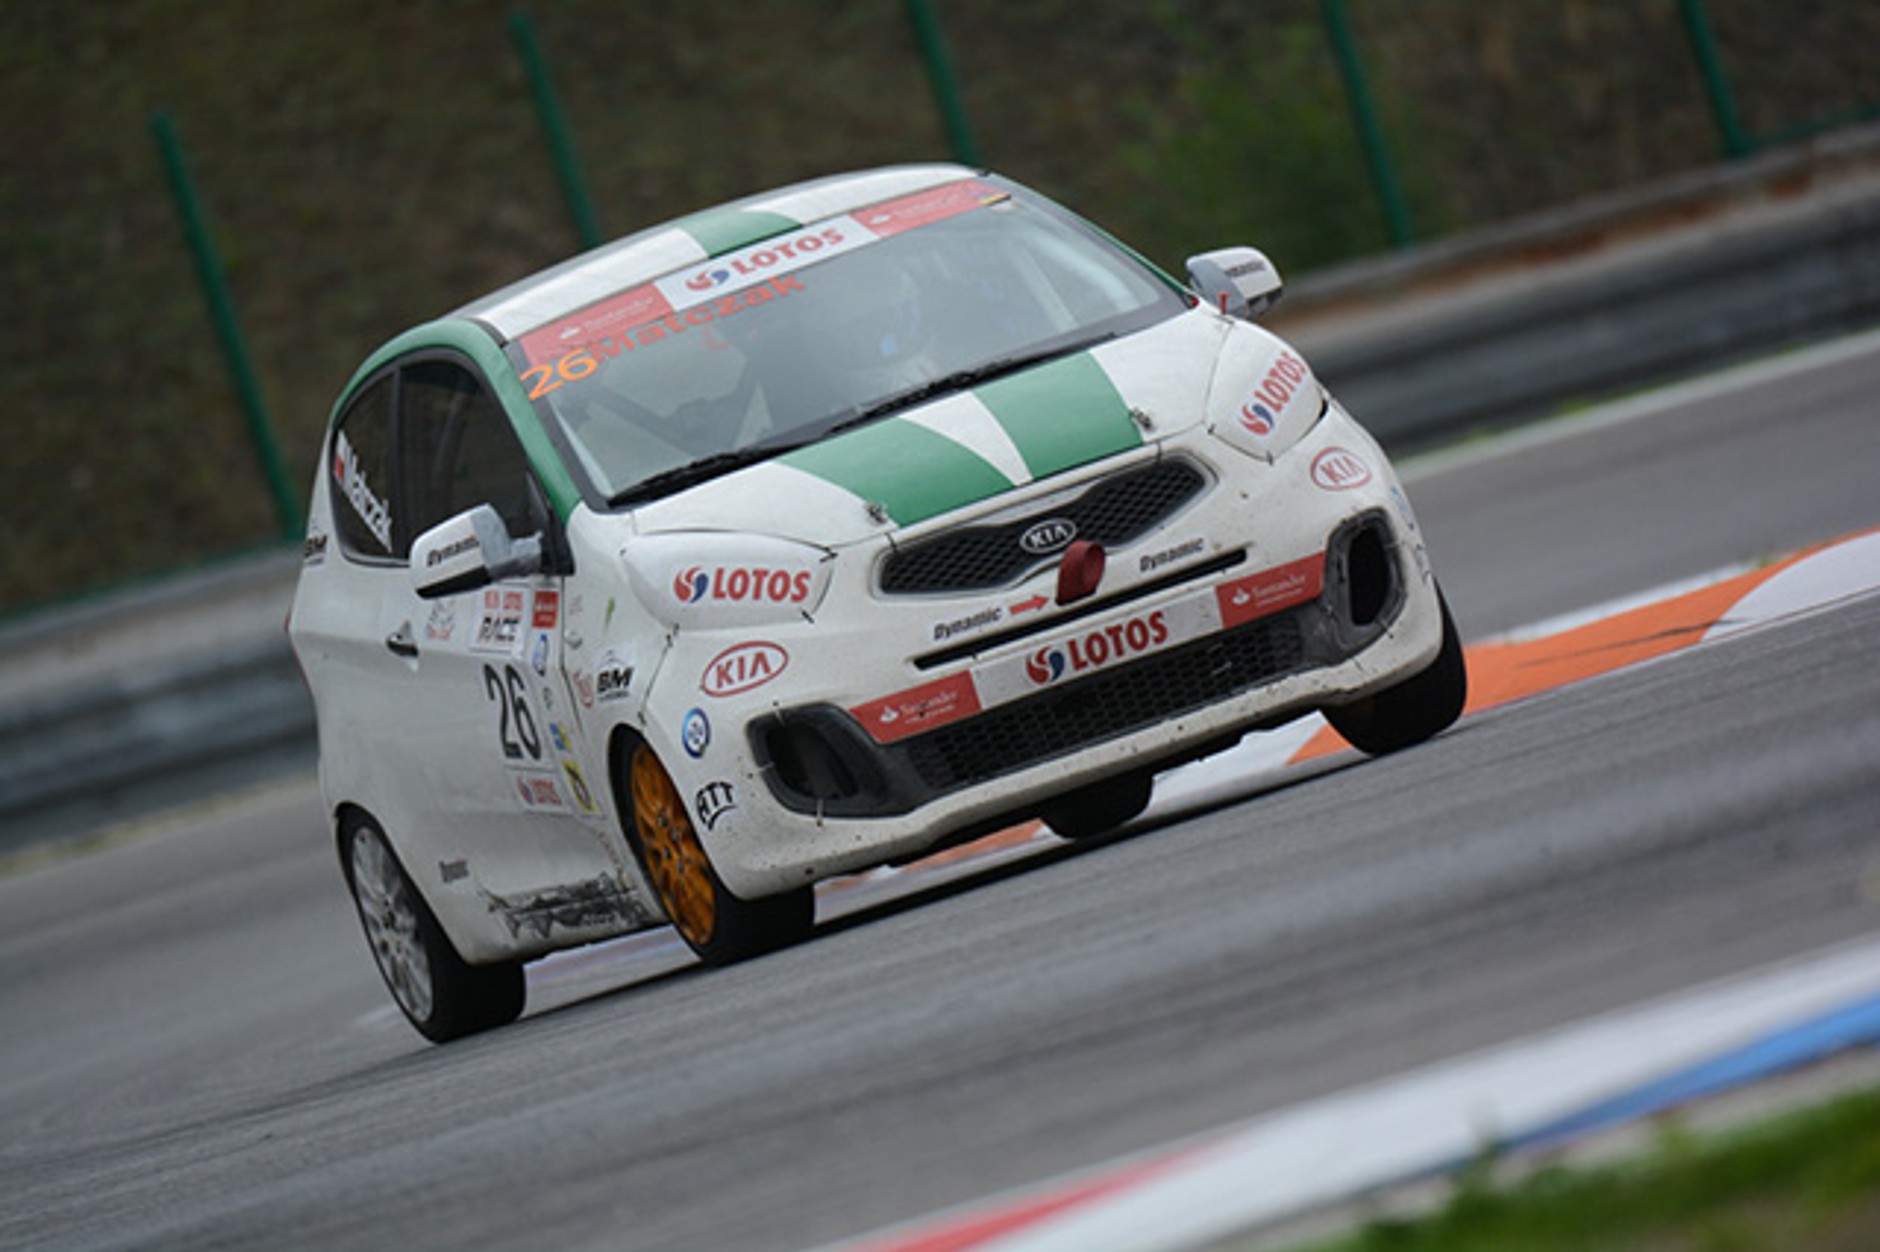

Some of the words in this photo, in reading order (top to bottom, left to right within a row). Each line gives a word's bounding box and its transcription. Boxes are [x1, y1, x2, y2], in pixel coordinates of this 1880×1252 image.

[730, 228, 844, 275] LOTOS
[587, 274, 807, 364] Matczak
[519, 347, 598, 400] 26
[1254, 350, 1308, 413] LOTOS
[1319, 454, 1364, 485] KIA
[1030, 525, 1068, 549] KIA
[1139, 537, 1203, 572] Dynamic
[711, 566, 811, 602] LOTOS
[934, 606, 1001, 640] Dynamic
[1066, 610, 1168, 672] LOTOS
[715, 651, 771, 689] KIA
[483, 664, 542, 761] 26
